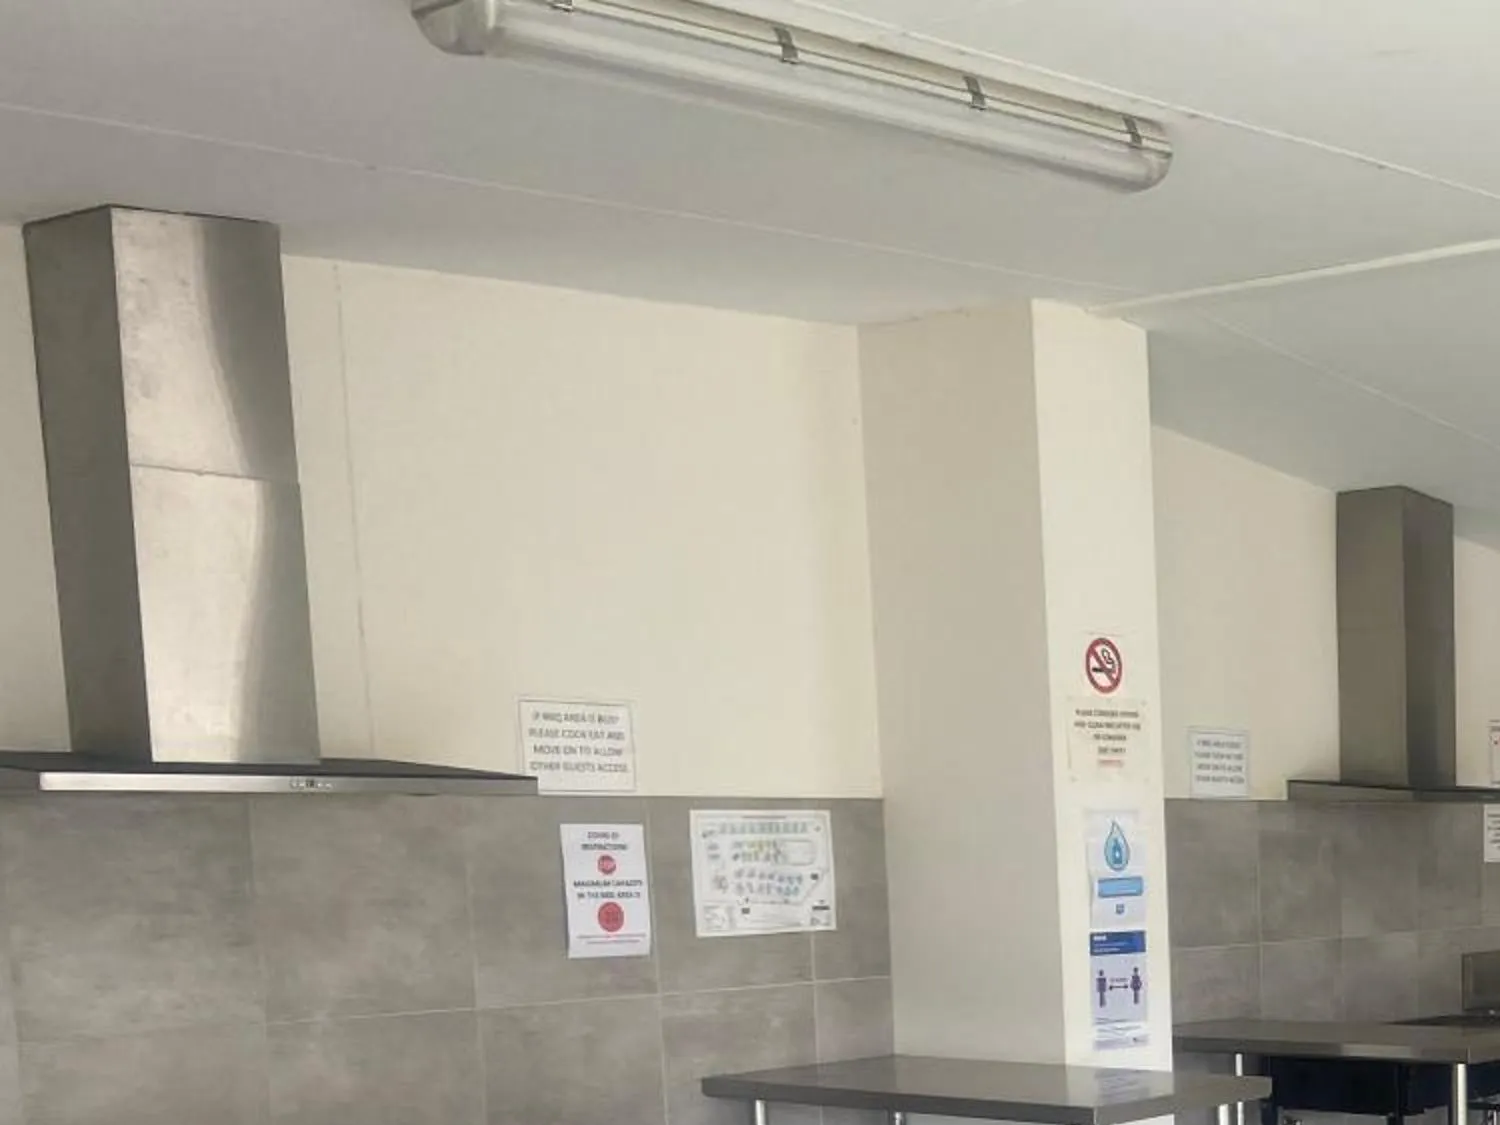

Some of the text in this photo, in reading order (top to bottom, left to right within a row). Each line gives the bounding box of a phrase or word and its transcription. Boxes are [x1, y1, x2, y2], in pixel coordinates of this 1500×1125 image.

[528, 728, 560, 738] PLEASE
[561, 729, 586, 739] COOK
[533, 744, 623, 757] MOVE ON TO ALLOW
[529, 761, 560, 771] OTHER
[562, 761, 595, 772] GUESTS
